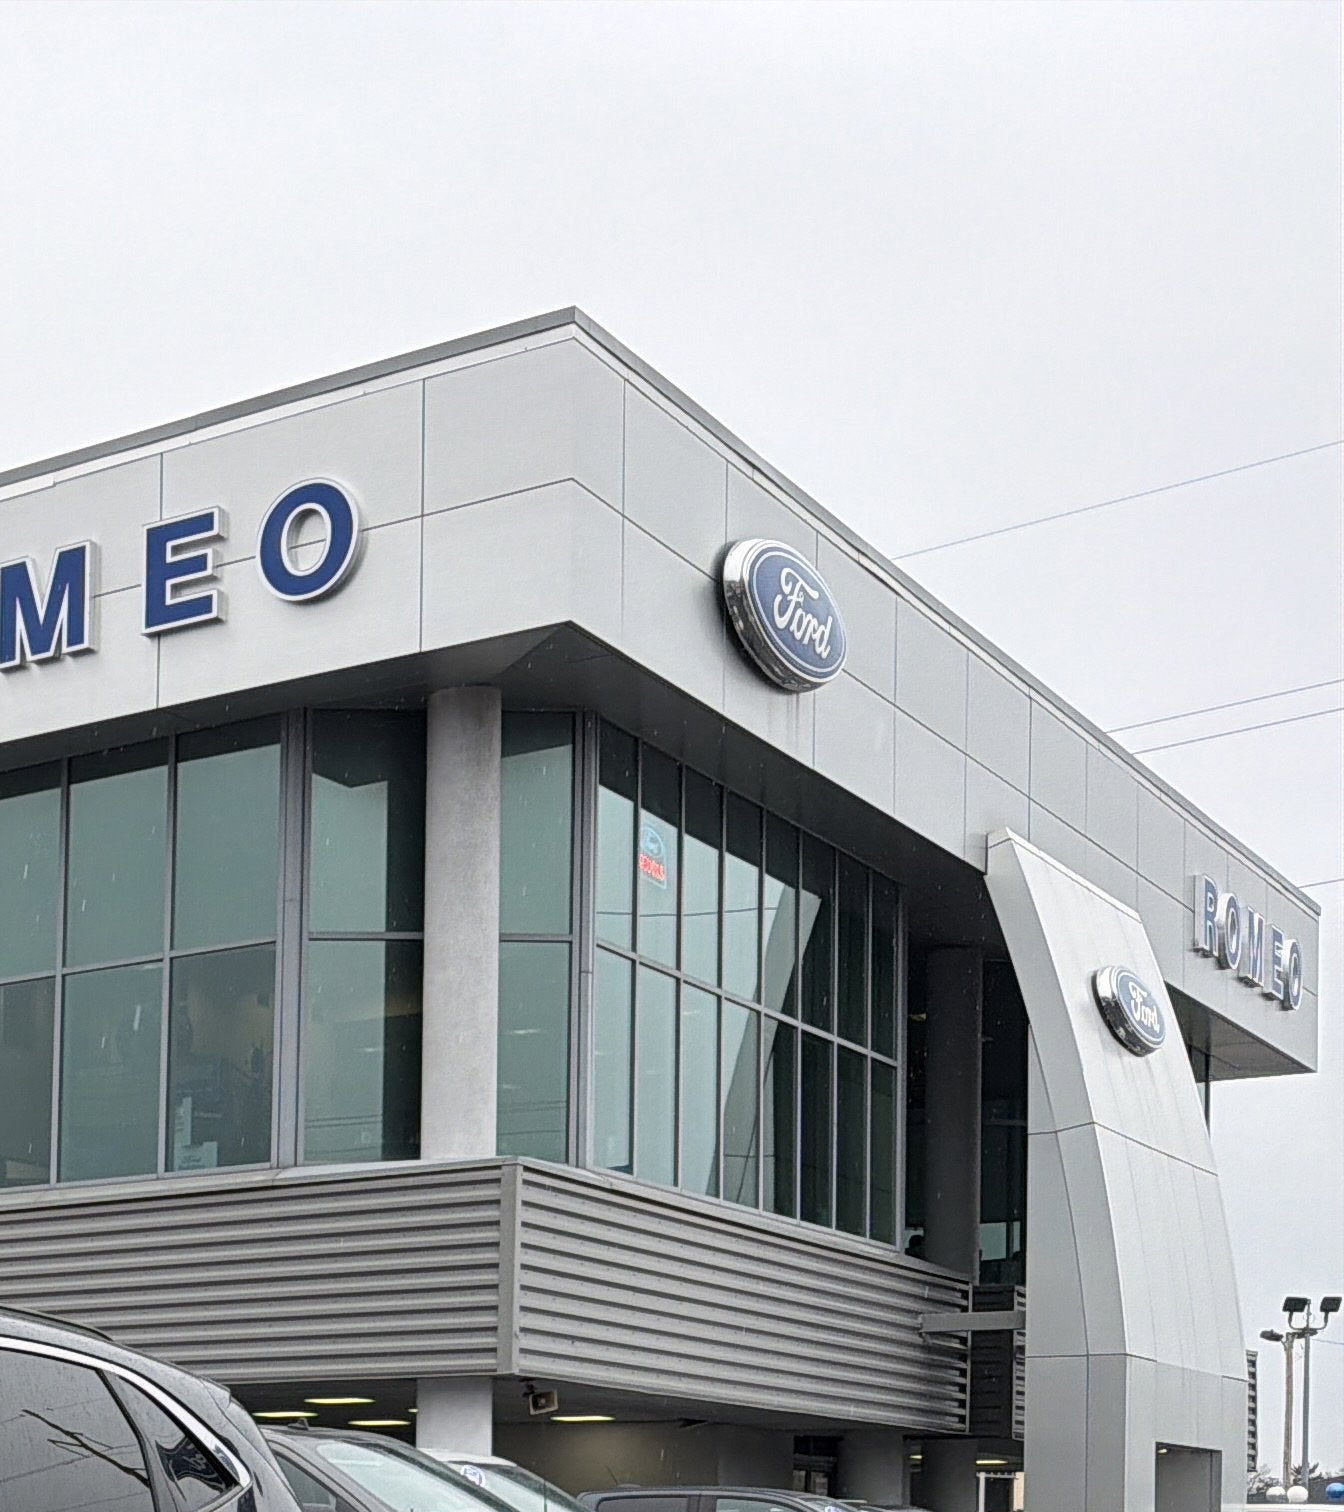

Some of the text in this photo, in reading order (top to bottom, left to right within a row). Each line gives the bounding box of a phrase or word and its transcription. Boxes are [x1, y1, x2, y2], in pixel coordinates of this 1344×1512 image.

[773, 567, 833, 660] Ford
[1200, 873, 1304, 1011] ROMEO
[1128, 981, 1161, 1032] Ford
